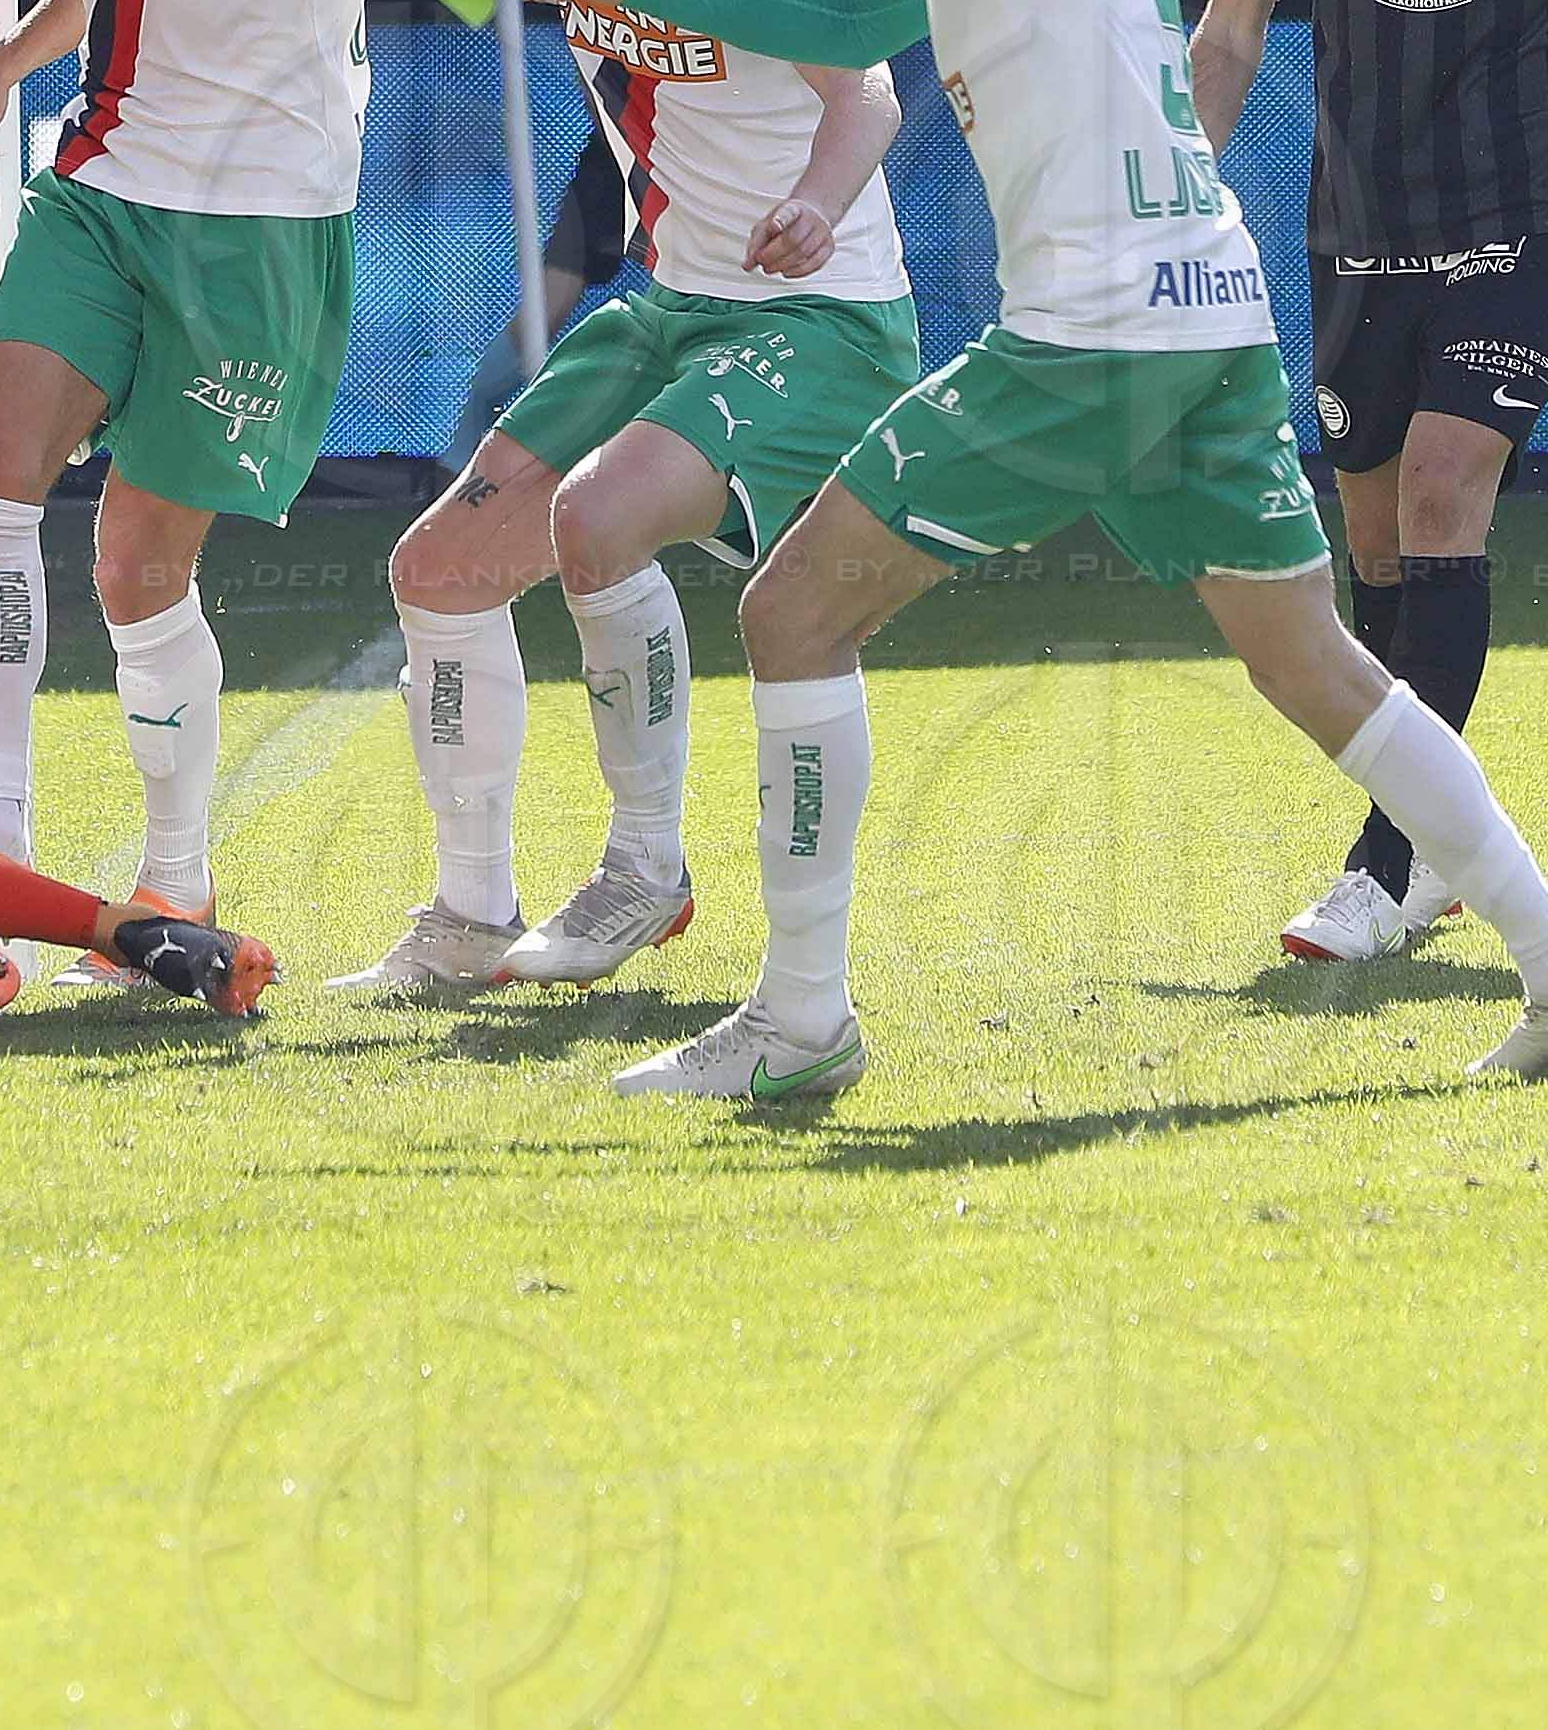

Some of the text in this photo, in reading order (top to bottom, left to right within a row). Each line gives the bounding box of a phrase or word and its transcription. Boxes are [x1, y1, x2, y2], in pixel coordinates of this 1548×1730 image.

[562, 0, 717, 75] NERGIE
[1147, 260, 1264, 309] Allianz
[1445, 257, 1516, 287] HOLDING
